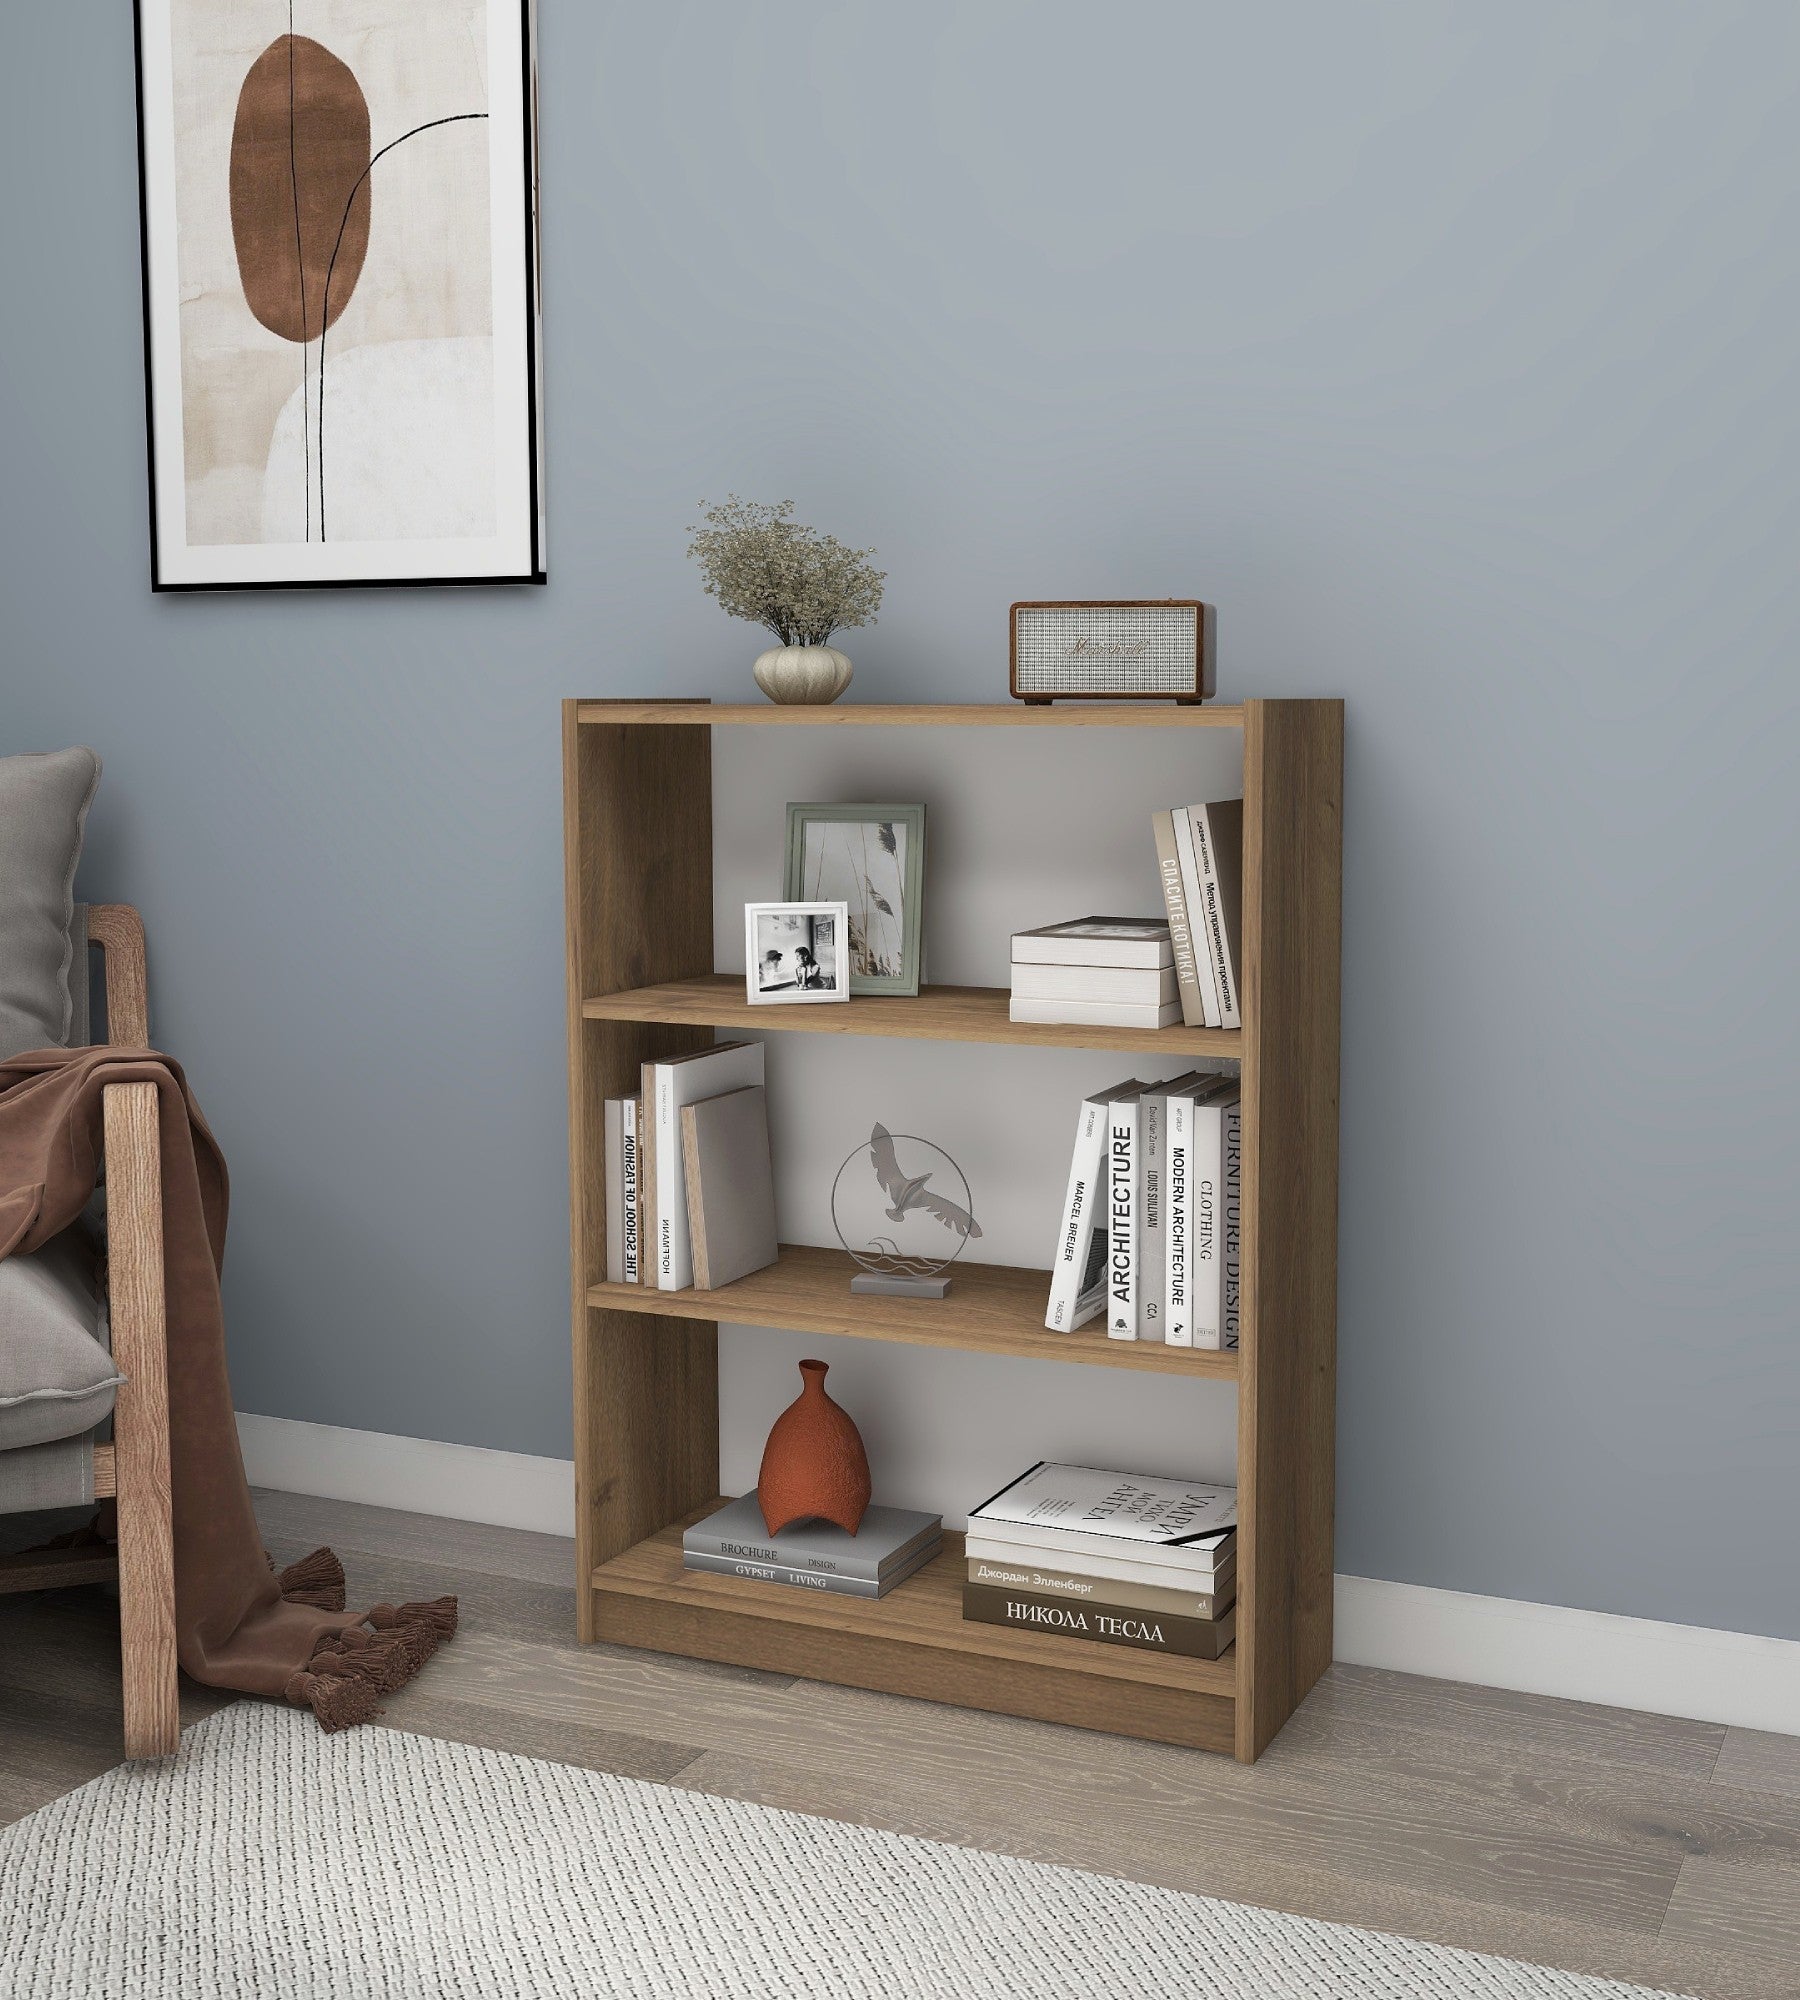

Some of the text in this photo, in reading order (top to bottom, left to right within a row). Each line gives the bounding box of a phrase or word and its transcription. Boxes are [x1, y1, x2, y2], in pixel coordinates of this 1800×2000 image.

[1064, 636, 1150, 655] Marshall
[1162, 858, 1195, 984] СПАСИТЕ КОТИКА!
[1205, 882, 1232, 1012] Метод управления проектами
[1064, 1180, 1085, 1262] MARCEL BREUER
[1113, 1126, 1131, 1302] ARCHITECTURE
[1147, 1170, 1158, 1228] LOUIS SULLIVAN
[1200, 1180, 1213, 1261] CLOTHING
[1172, 1147, 1184, 1306] MODERN ARCHITECTURE
[1226, 1113, 1240, 1349] FURNITURE DESIGN
[1082, 1483, 1140, 1520] АНГЕЛ
[1122, 1492, 1157, 1514] МОЙ
[1149, 1494, 1216, 1535] УМРИ
[721, 1543, 777, 1561] BROCHURE
[735, 1565, 827, 1588] GYPSET LIVING
[977, 1565, 1093, 1595] Джордан Элленберг
[1005, 1601, 1166, 1644] НИКОЛА ТЕСЛА
